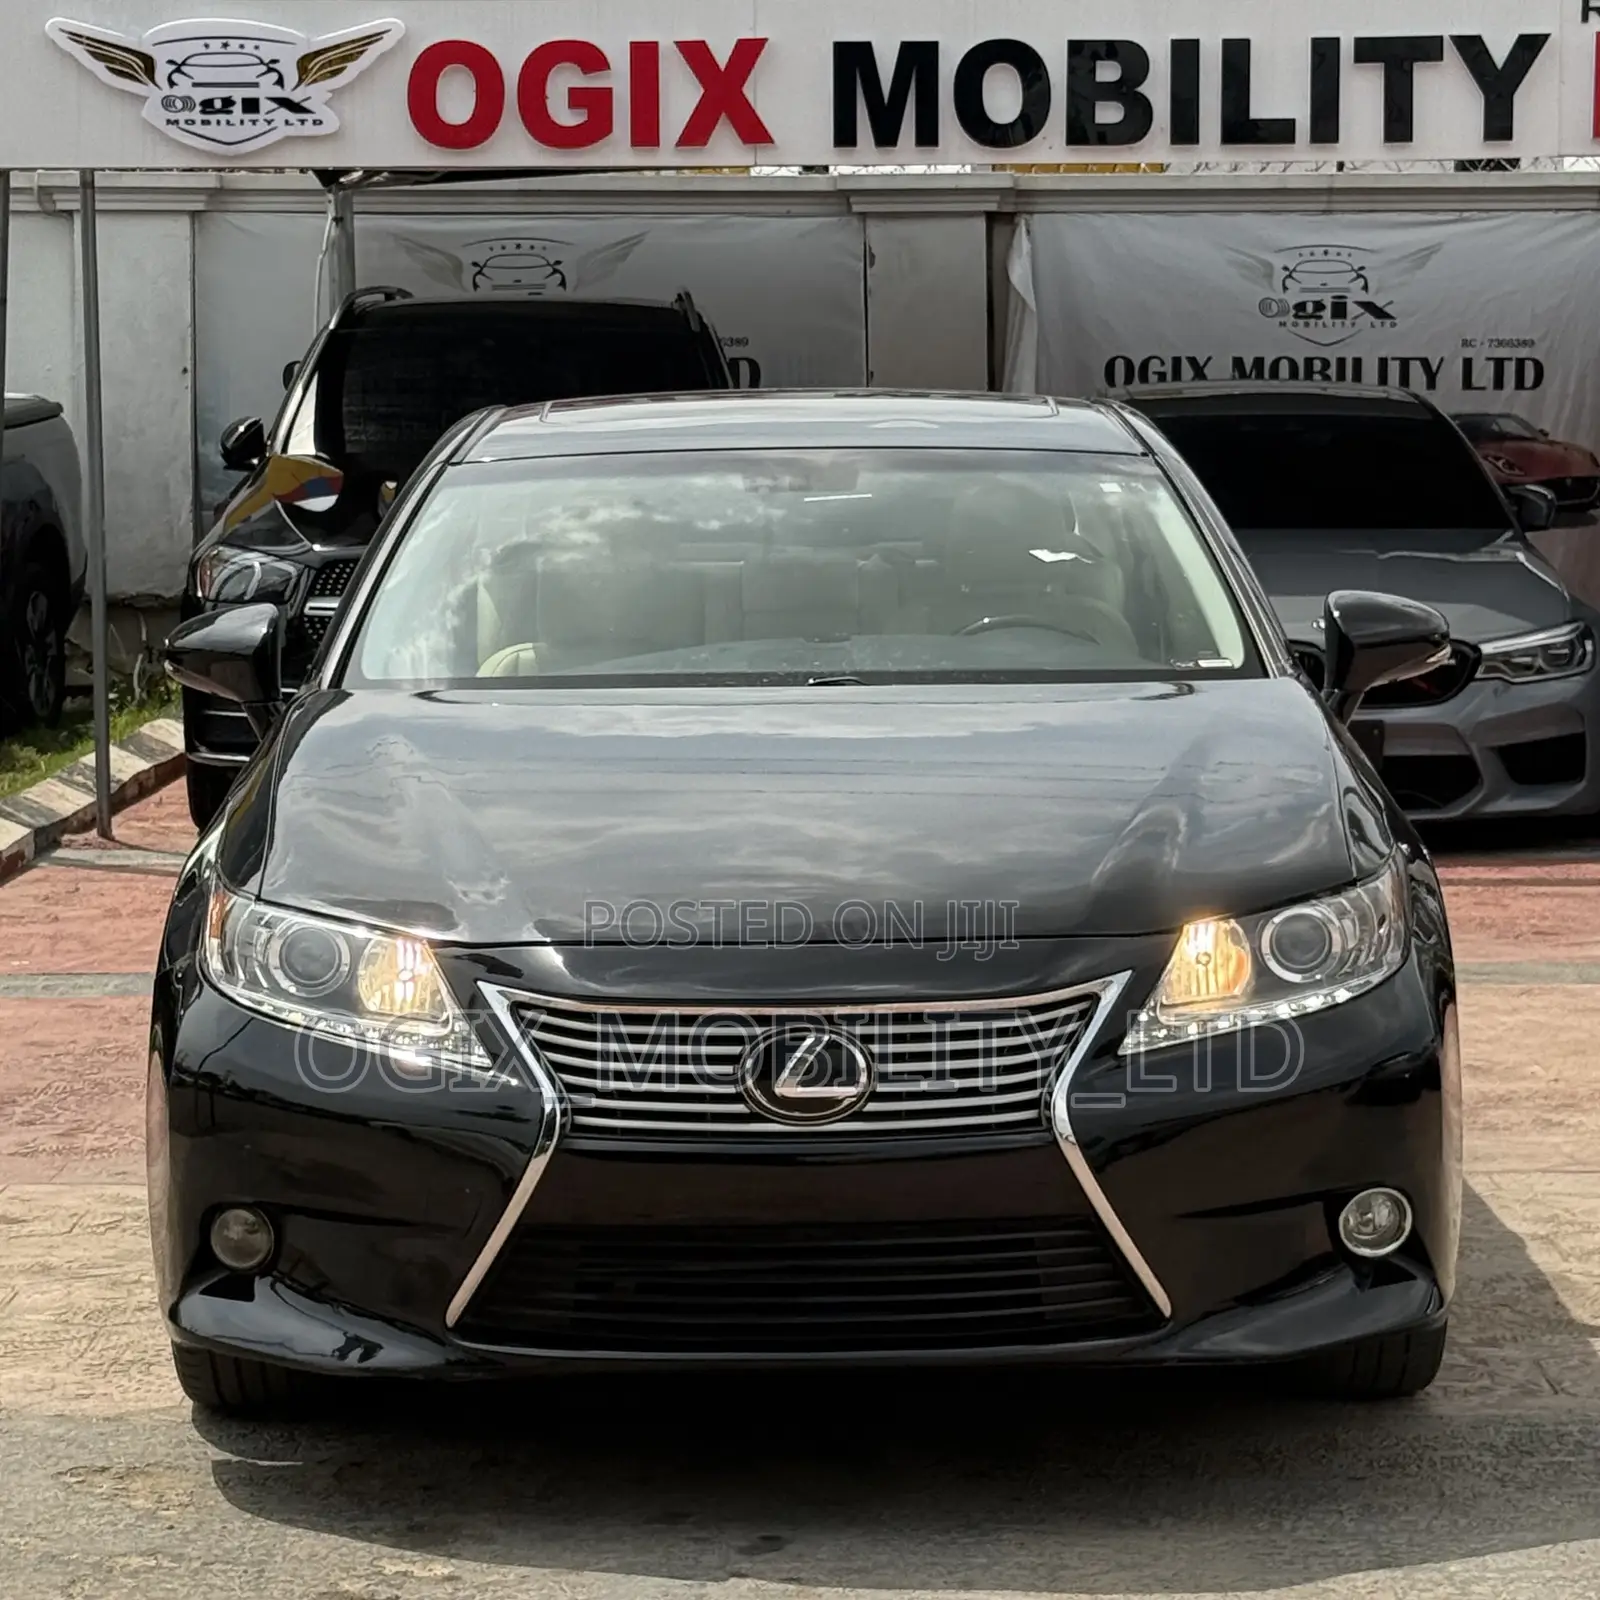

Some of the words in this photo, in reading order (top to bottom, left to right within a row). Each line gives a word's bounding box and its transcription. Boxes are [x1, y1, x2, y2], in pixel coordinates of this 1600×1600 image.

[406, 37, 775, 150] OGIX
[832, 33, 1551, 149] MOBILITY
[165, 118, 276, 126] MOBILITY
[284, 118, 324, 126] LTD
[1104, 355, 1212, 388] OGIX
[1231, 355, 1444, 390] MOBILITY
[1461, 356, 1545, 391] LTD
